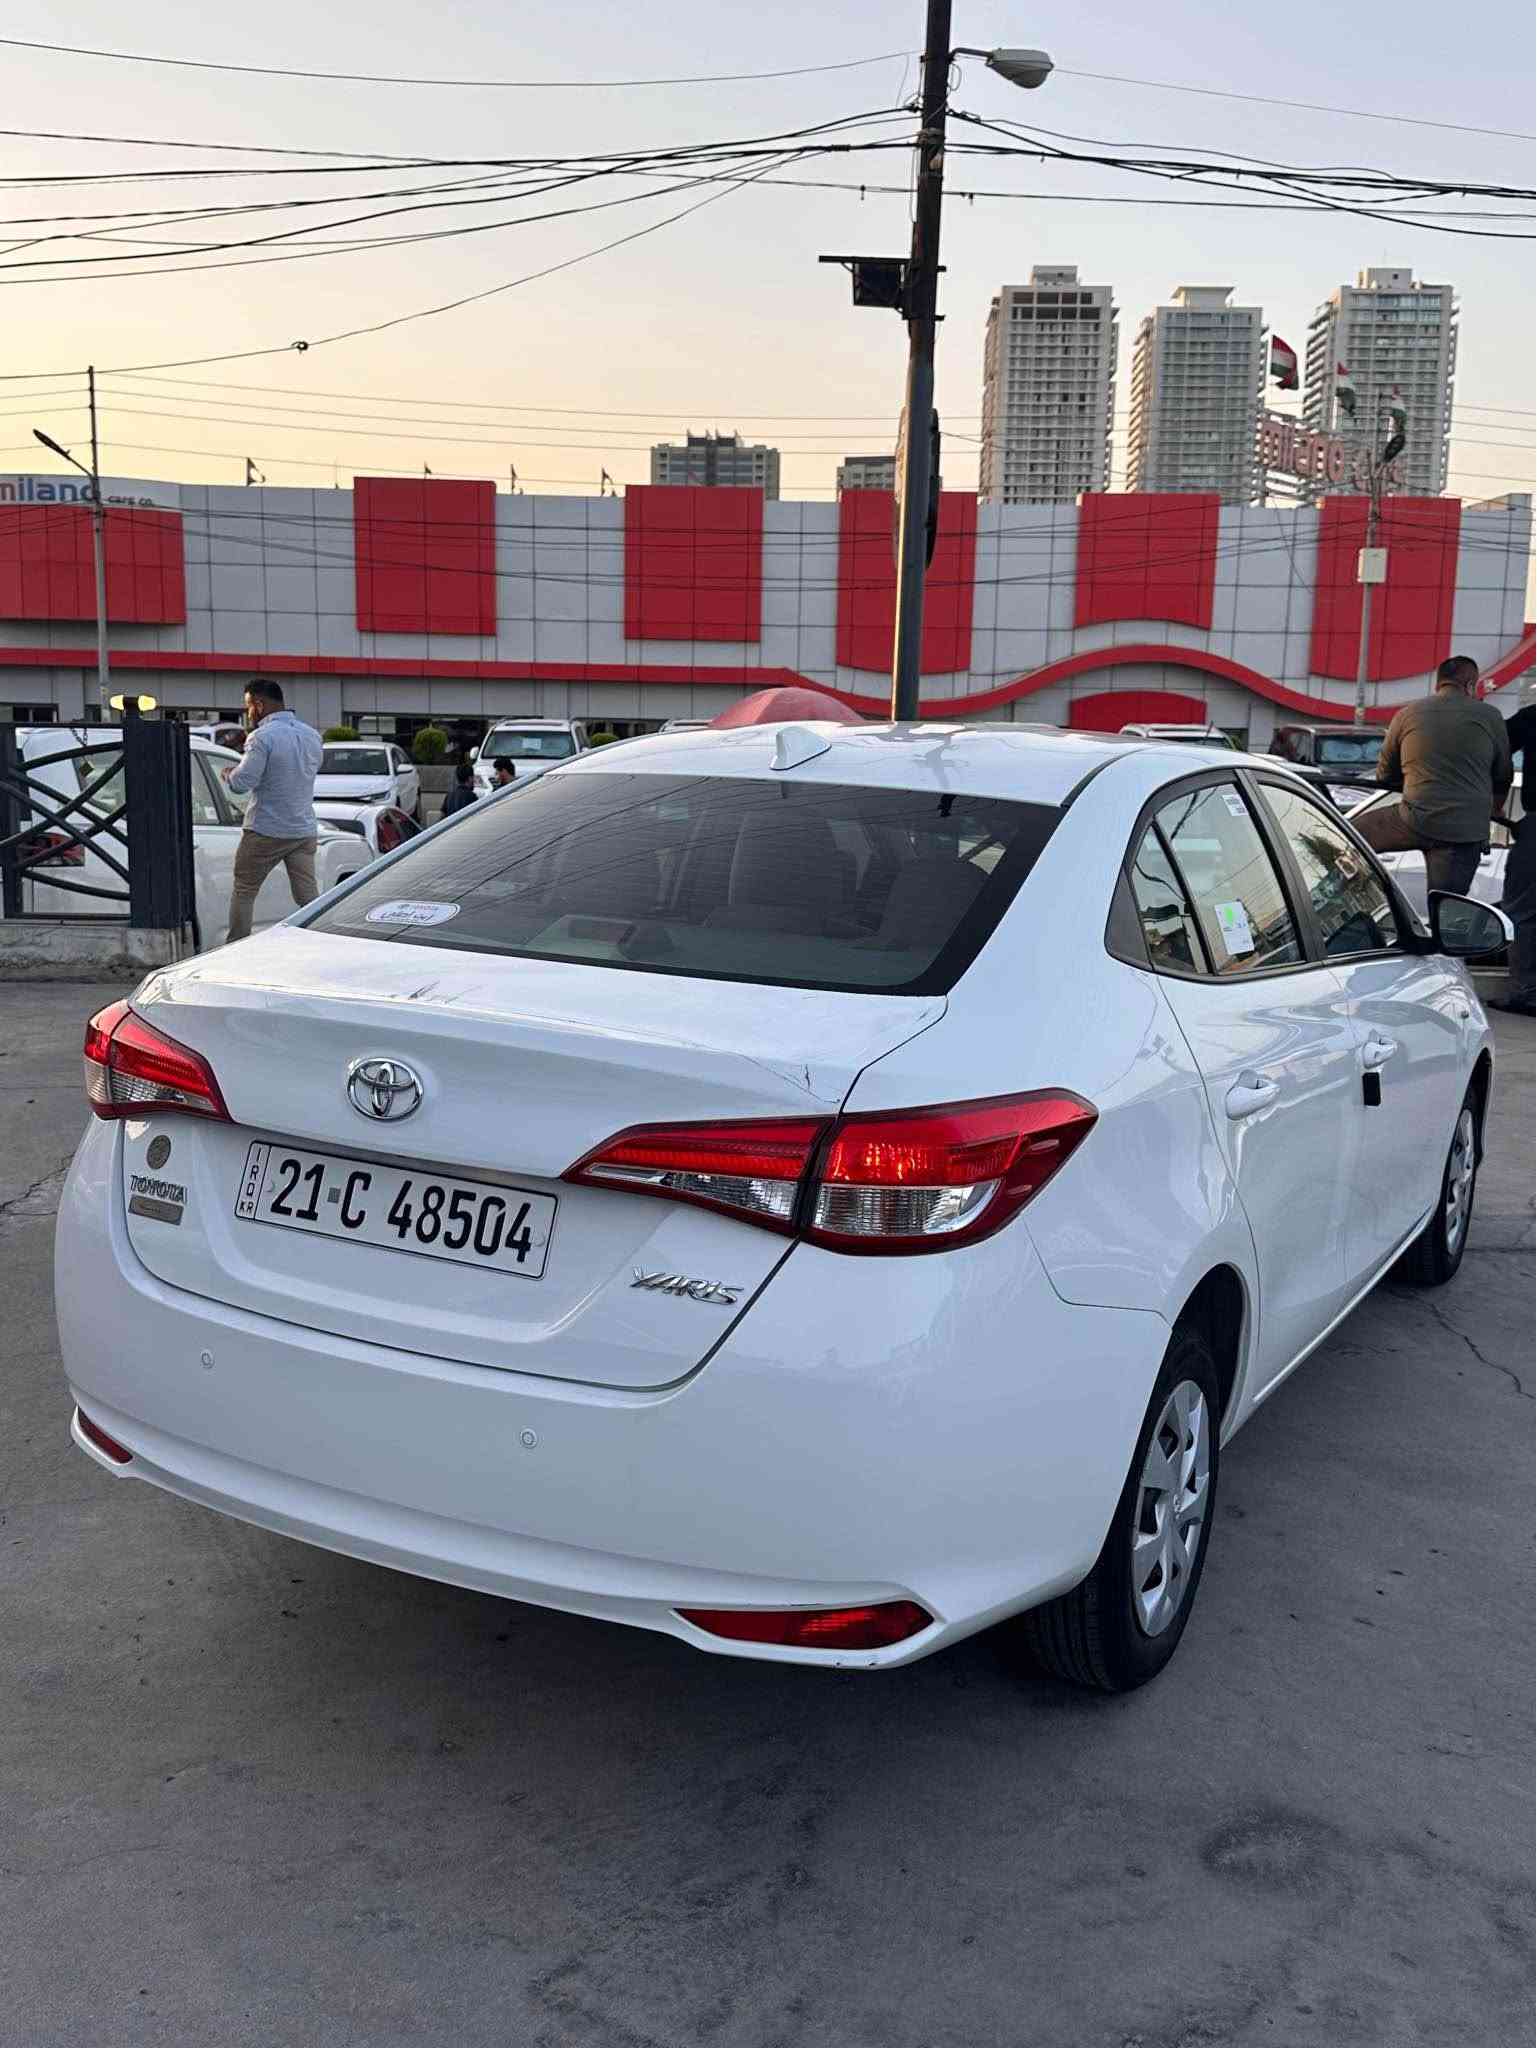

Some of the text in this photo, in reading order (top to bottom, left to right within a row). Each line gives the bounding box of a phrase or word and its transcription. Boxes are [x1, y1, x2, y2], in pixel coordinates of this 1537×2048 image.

[270, 1158, 533, 1263] 21 C 48504
[629, 1265, 745, 1305] YARIS
